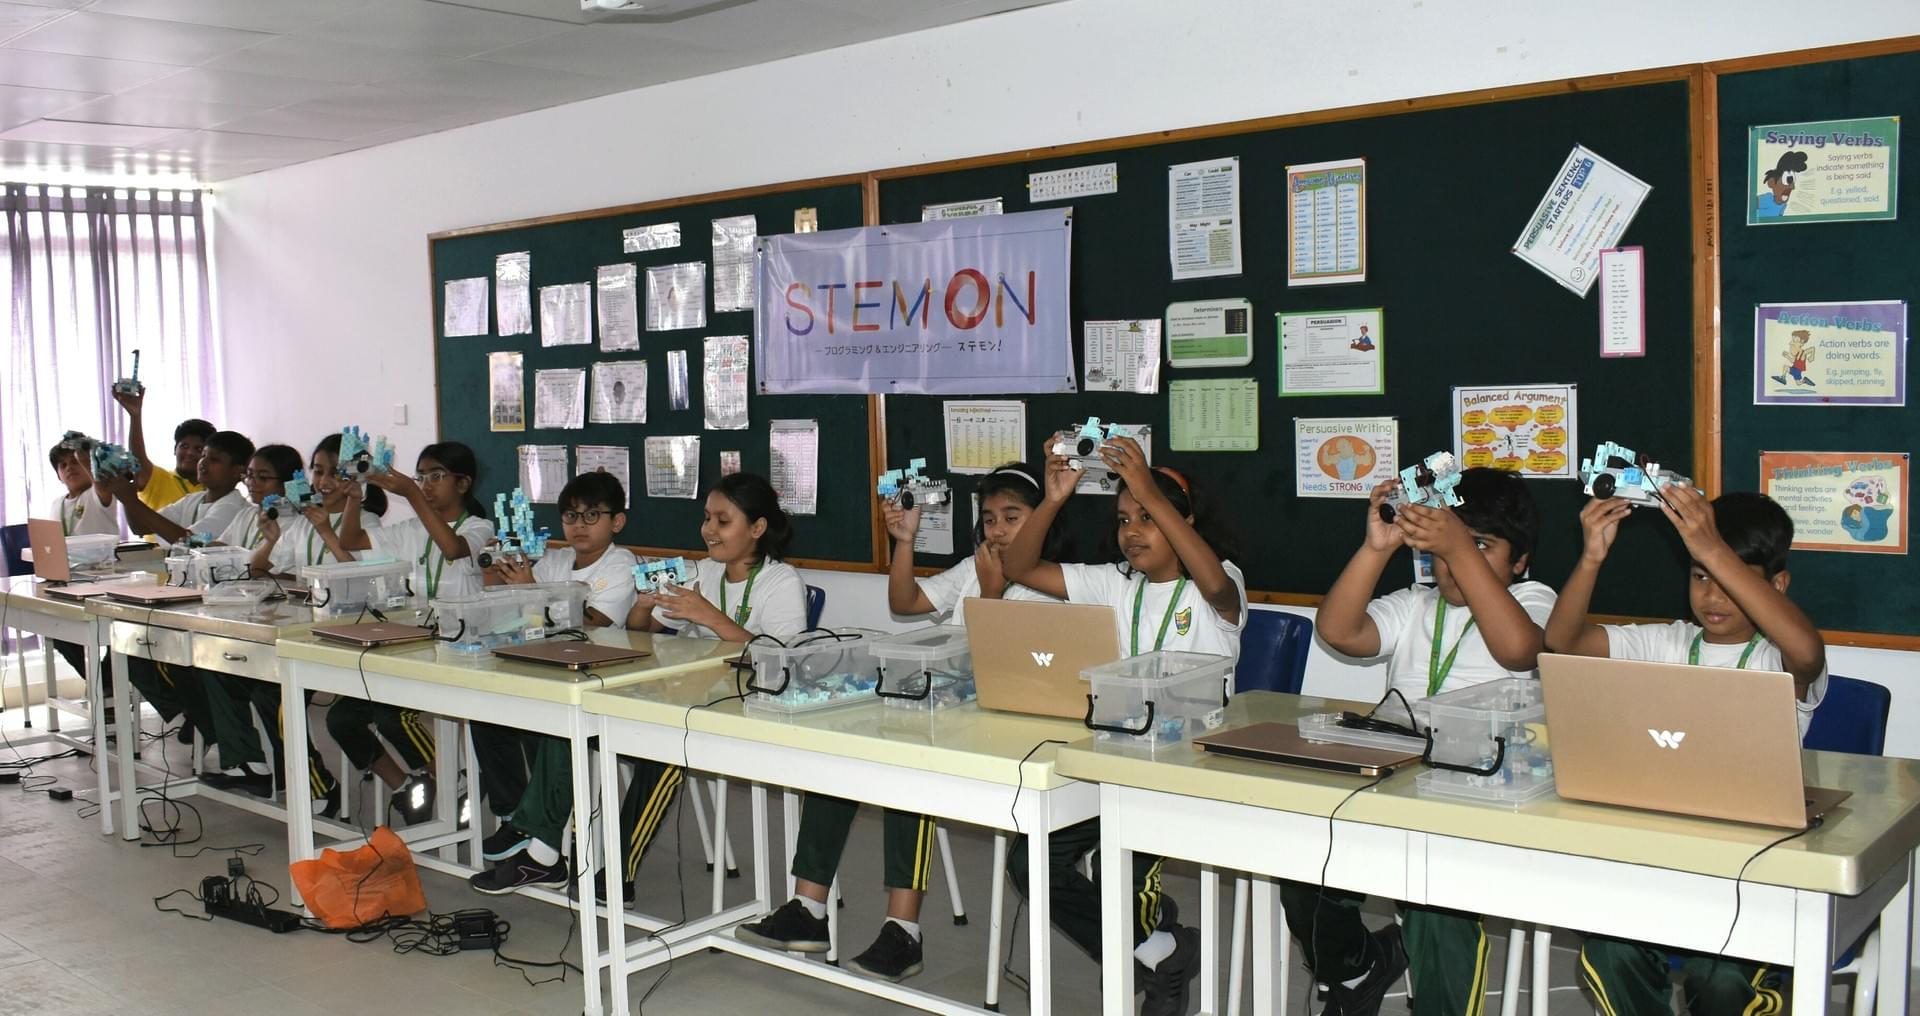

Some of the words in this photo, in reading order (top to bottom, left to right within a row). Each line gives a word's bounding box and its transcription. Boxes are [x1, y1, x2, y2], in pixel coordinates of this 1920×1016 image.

[1766, 131, 1826, 148] Saying
[1832, 132, 1883, 147] Verbs
[1834, 172, 1854, 180] being
[1524, 199, 1558, 250] PERSUASIVE
[1554, 158, 1582, 198] SENTENCE
[1546, 189, 1574, 231] STARTERS
[784, 268, 1036, 336] STEMON
[1777, 311, 1830, 328] Action
[1833, 315, 1882, 332] Verbs
[1820, 340, 1846, 348] Action
[1848, 339, 1872, 348] verbs
[1874, 340, 1890, 348] are
[1826, 350, 1850, 362] doing
[1464, 392, 1510, 407] Balanced
[1514, 390, 1567, 405] Argument
[1300, 423, 1352, 434] Persuasive
[1354, 422, 1392, 436] Writing
[1773, 463, 1843, 480] Thinking
[1846, 456, 1893, 473] Verbs
[1302, 483, 1327, 492] Needs
[1330, 482, 1362, 492] STRONG
[1776, 485, 1802, 493] Thinking
